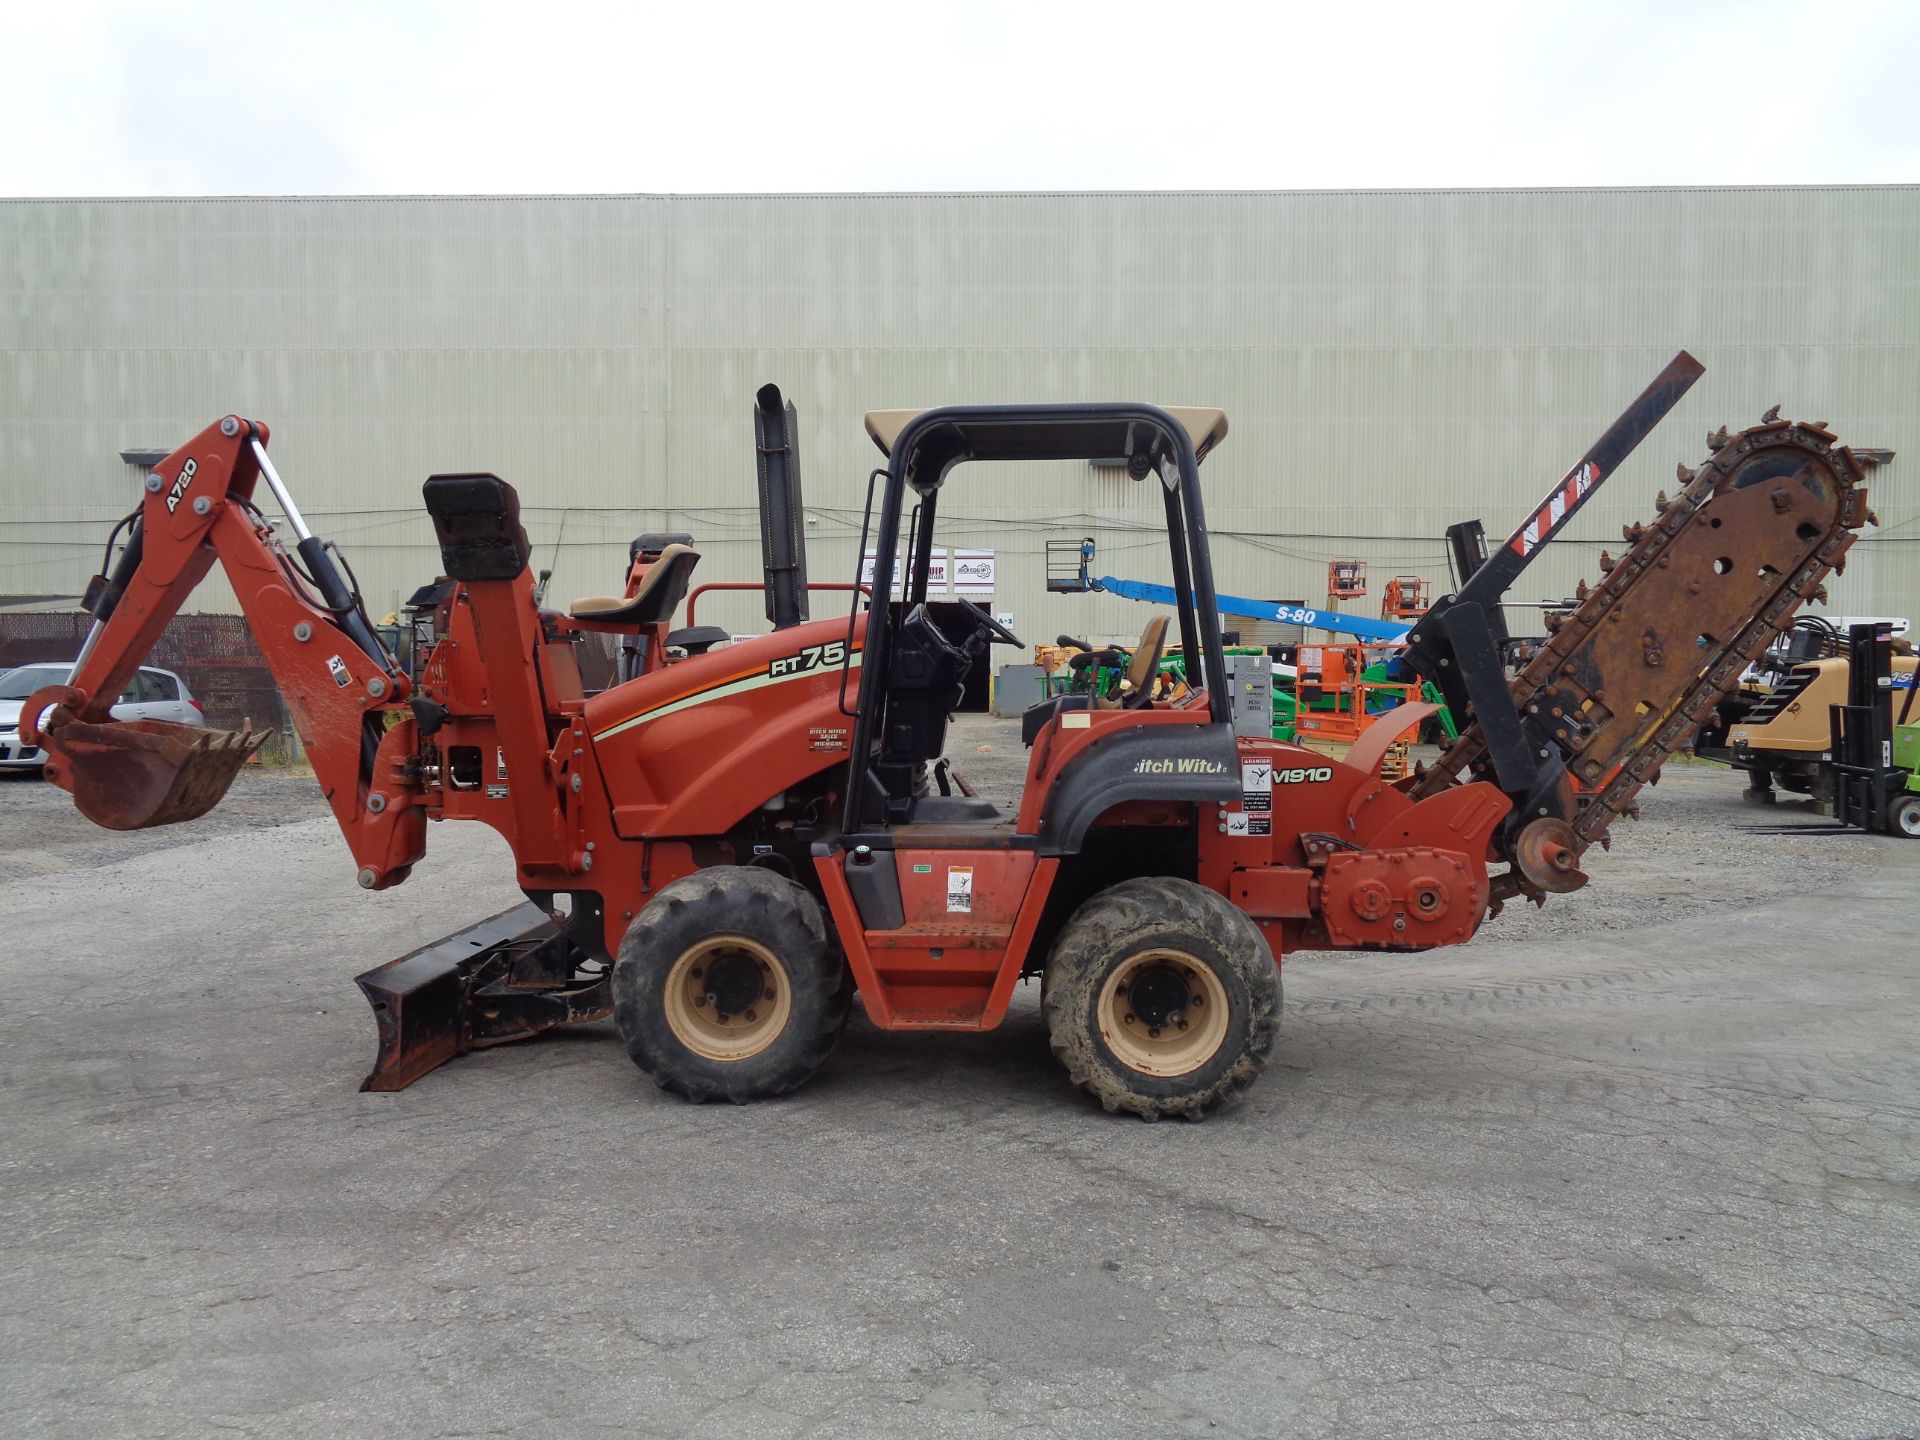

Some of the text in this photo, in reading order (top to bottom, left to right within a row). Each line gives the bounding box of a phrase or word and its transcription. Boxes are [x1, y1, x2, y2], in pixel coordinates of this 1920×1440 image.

[166, 458, 197, 513] A720
[1276, 606, 1316, 624] S-80
[1133, 759, 1174, 773] itch
